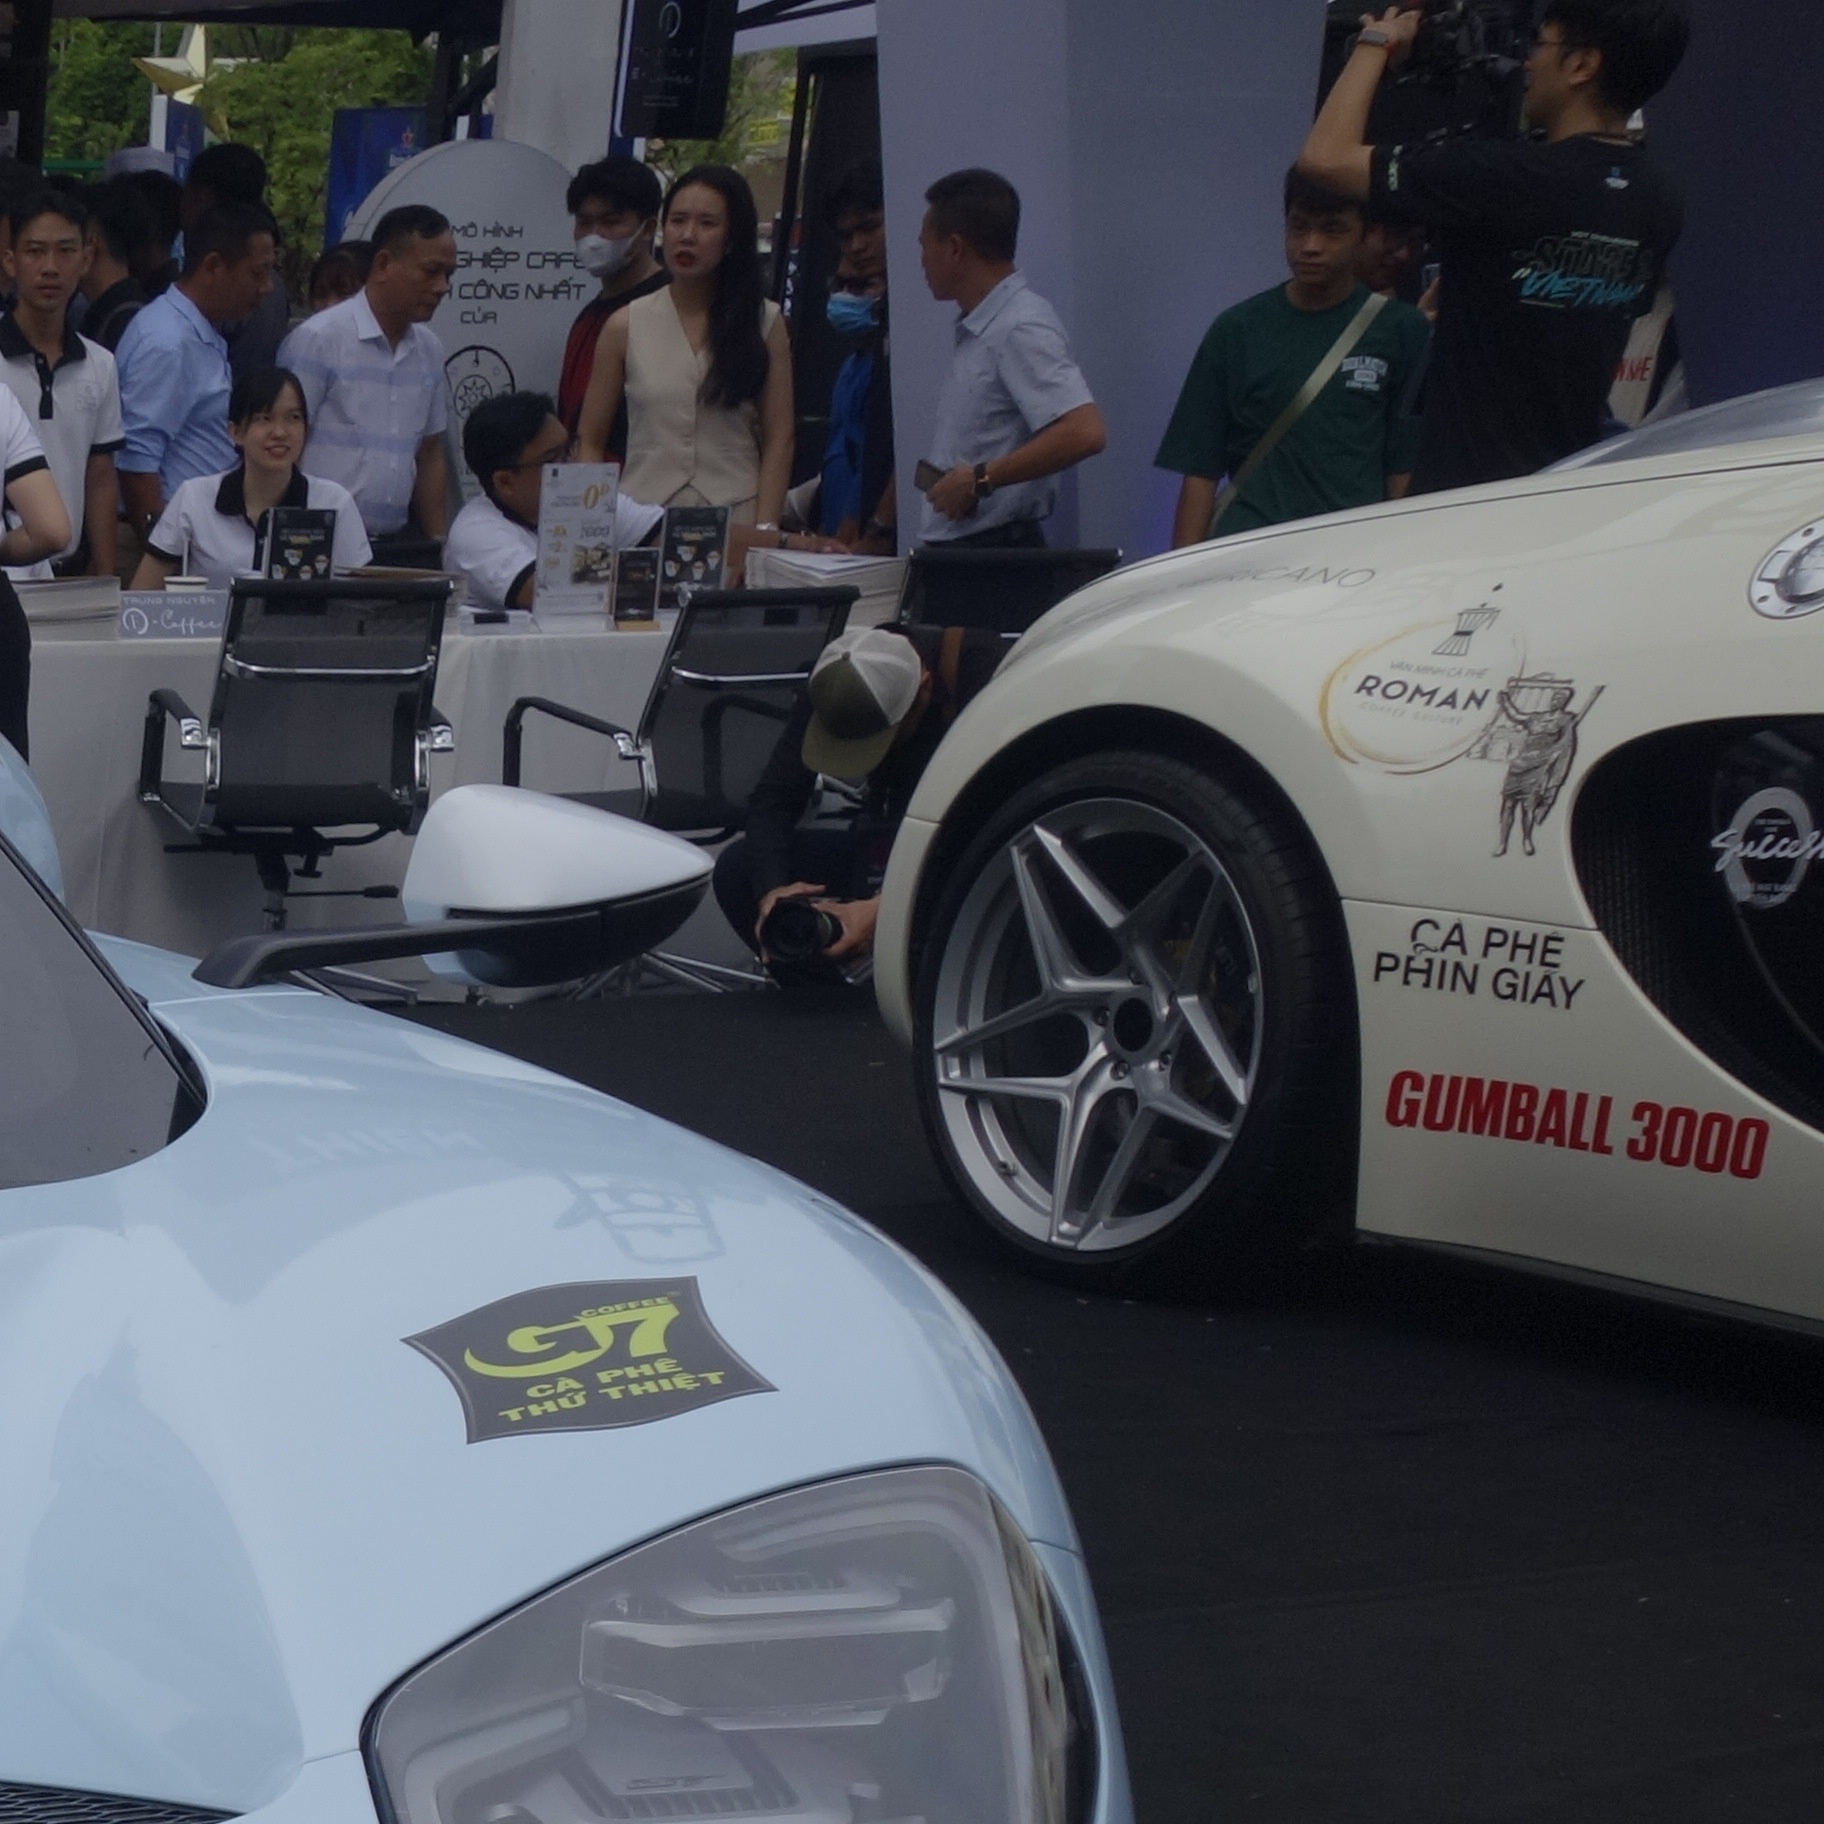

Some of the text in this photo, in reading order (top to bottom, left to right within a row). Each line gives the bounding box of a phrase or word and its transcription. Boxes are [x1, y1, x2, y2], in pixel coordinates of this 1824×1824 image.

[458, 278, 520, 300] CÔNG
[525, 276, 586, 300] NHẤT
[1354, 674, 1491, 711] ROMAN
[1373, 951, 1480, 995] PHIN
[1384, 1069, 1770, 1180] GUMBALL 3000
[580, 1296, 670, 1319] COFFEE
[463, 1302, 681, 1379] G7
[525, 1357, 684, 1399] CÀ PHÊ
[597, 1370, 726, 1401] THIỆT
